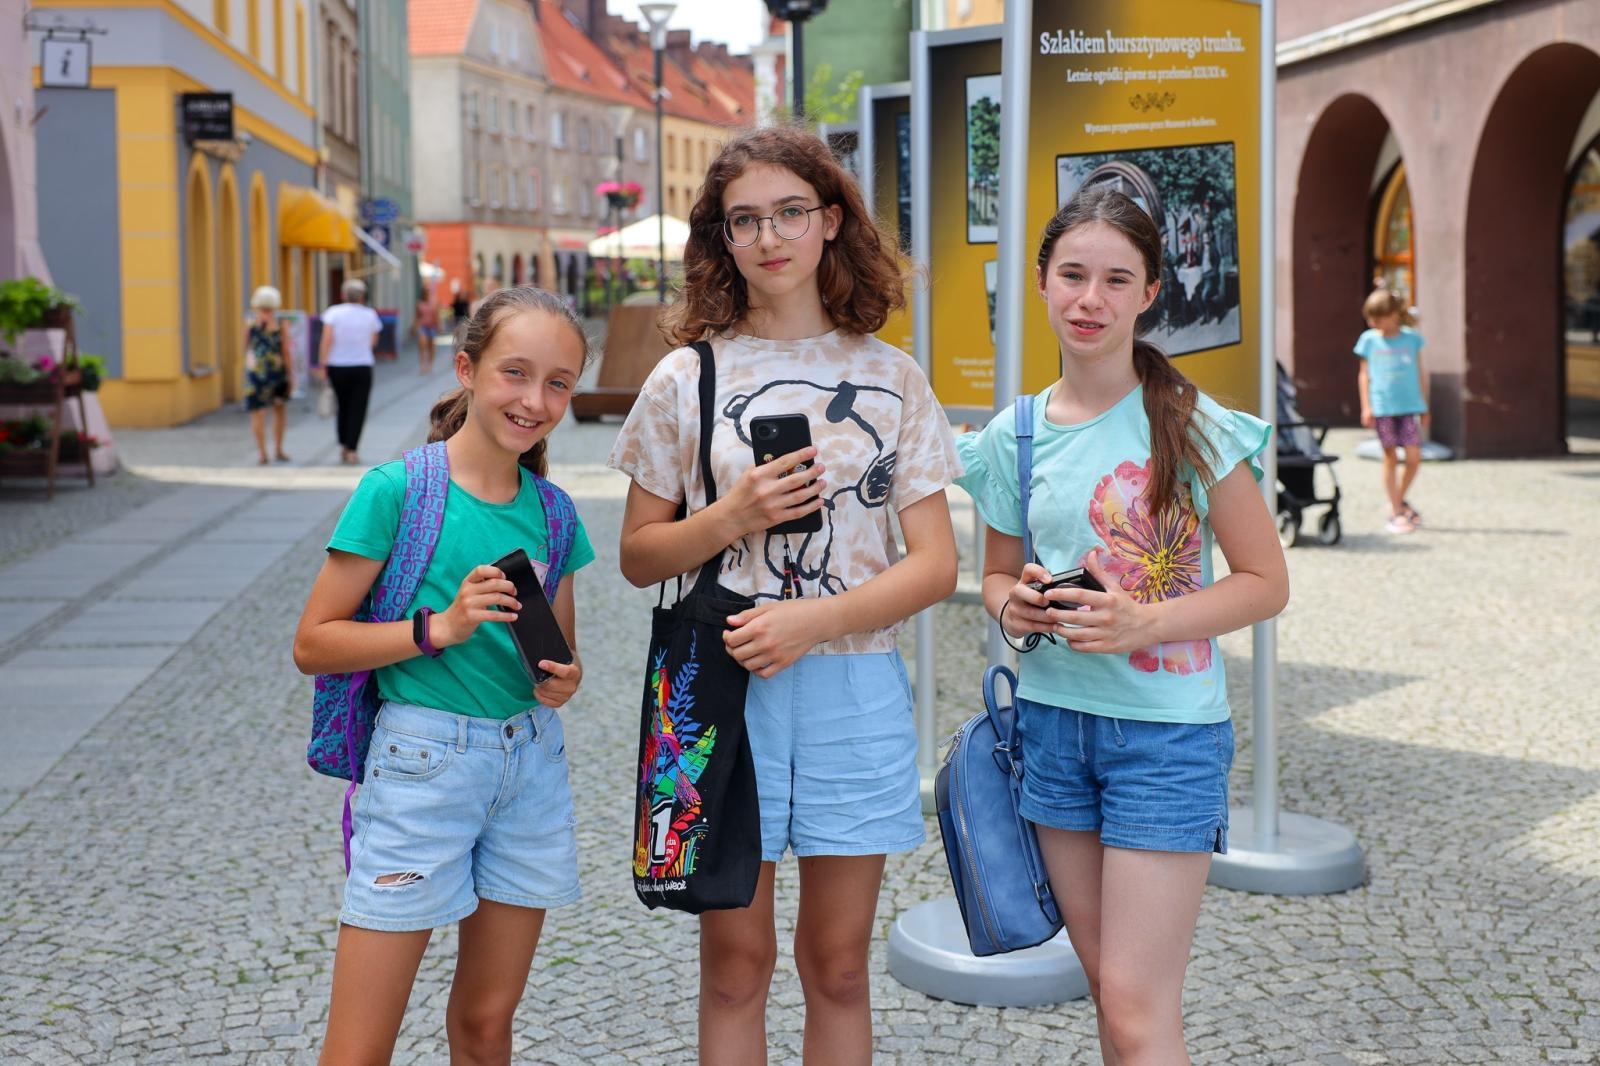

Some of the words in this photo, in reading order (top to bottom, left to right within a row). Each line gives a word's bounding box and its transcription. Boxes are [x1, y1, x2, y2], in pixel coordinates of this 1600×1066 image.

[1040, 30, 1105, 54] Szlakiem
[1106, 29, 1201, 59] bursztynowego
[1202, 31, 1246, 53] trunku.
[1066, 68, 1092, 83] Letnie
